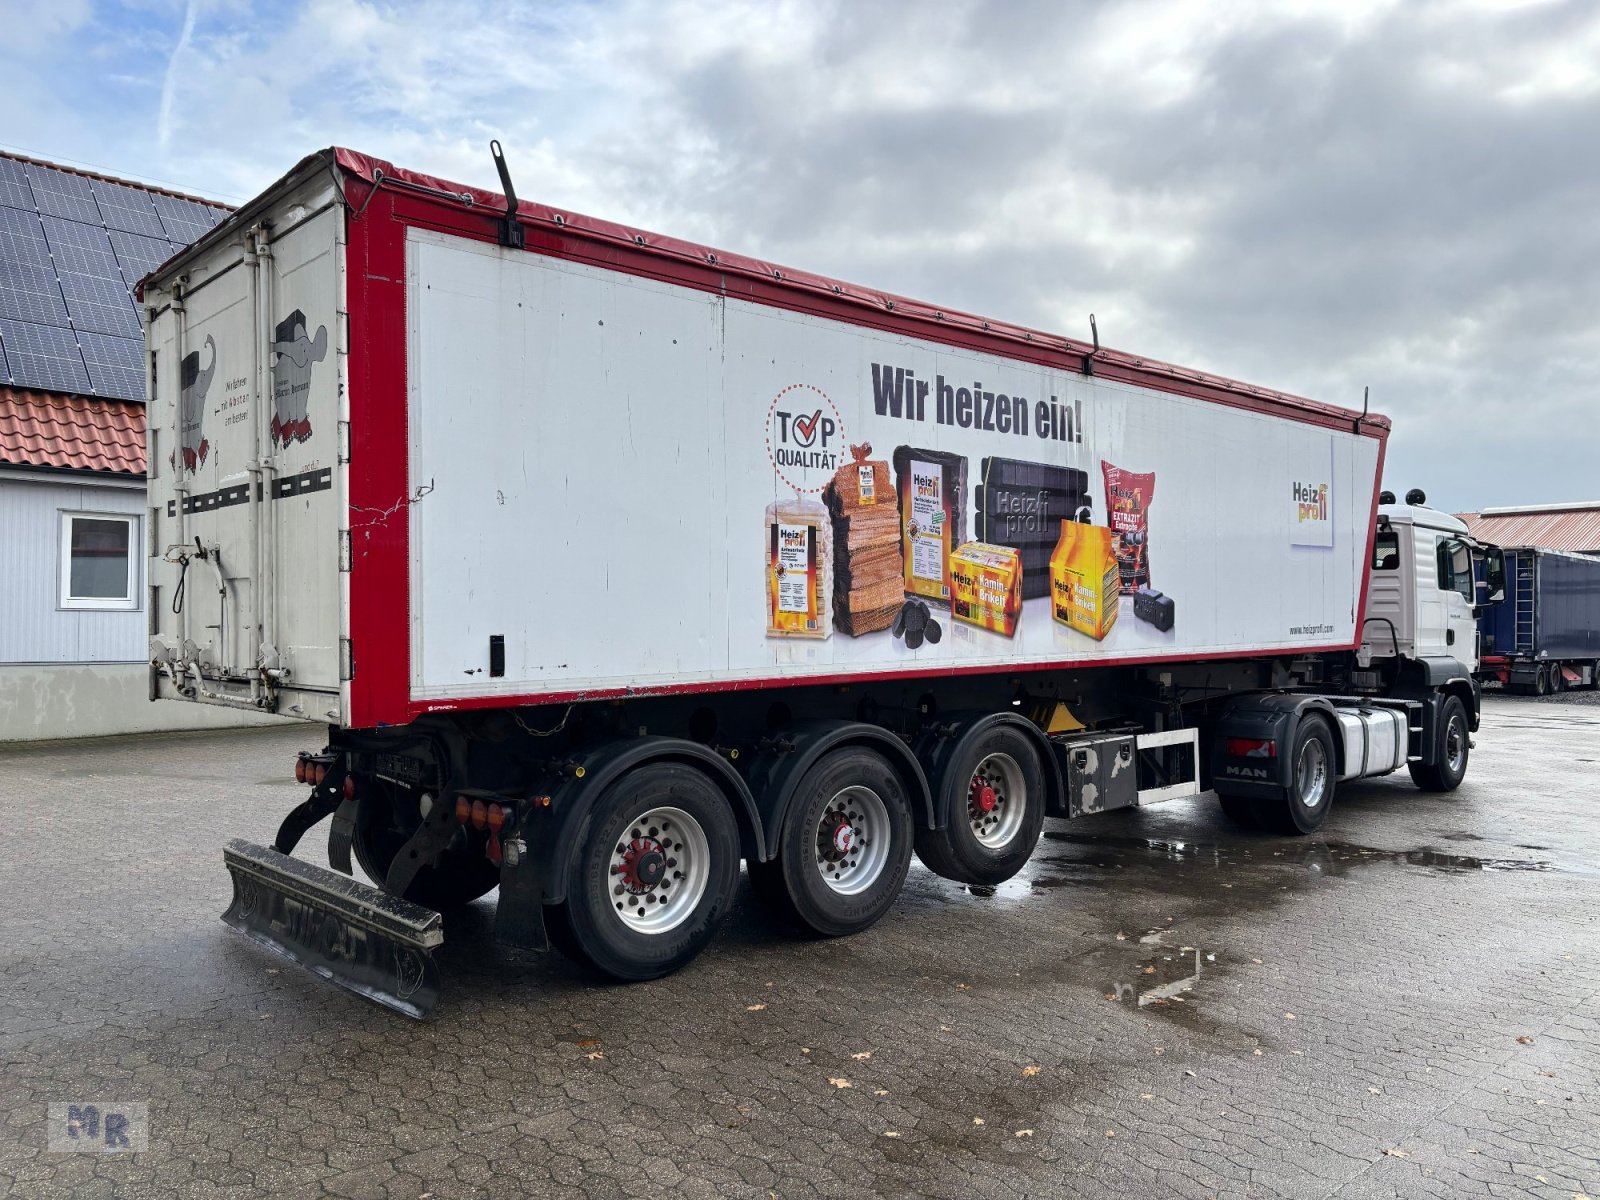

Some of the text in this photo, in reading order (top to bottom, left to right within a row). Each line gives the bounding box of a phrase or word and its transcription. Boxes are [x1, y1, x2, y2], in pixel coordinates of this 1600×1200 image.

[871, 362, 1082, 444] Wir heizen ein!
[777, 410, 835, 448] TOP
[776, 448, 837, 471] QUALITÄT
[914, 474, 932, 488] Heiz
[1292, 481, 1319, 503] Heiz
[997, 491, 1036, 514] Heiz
[1298, 483, 1328, 524] profi
[1006, 490, 1049, 538] profi
[1113, 511, 1140, 523] EXTRAZIT
[780, 529, 800, 539] Heiz
[954, 571, 972, 586] Heiz
[1054, 578, 1069, 593] Heiz
[1289, 624, 1335, 635] www.heizprofi.com
[1226, 766, 1268, 778] MAN
